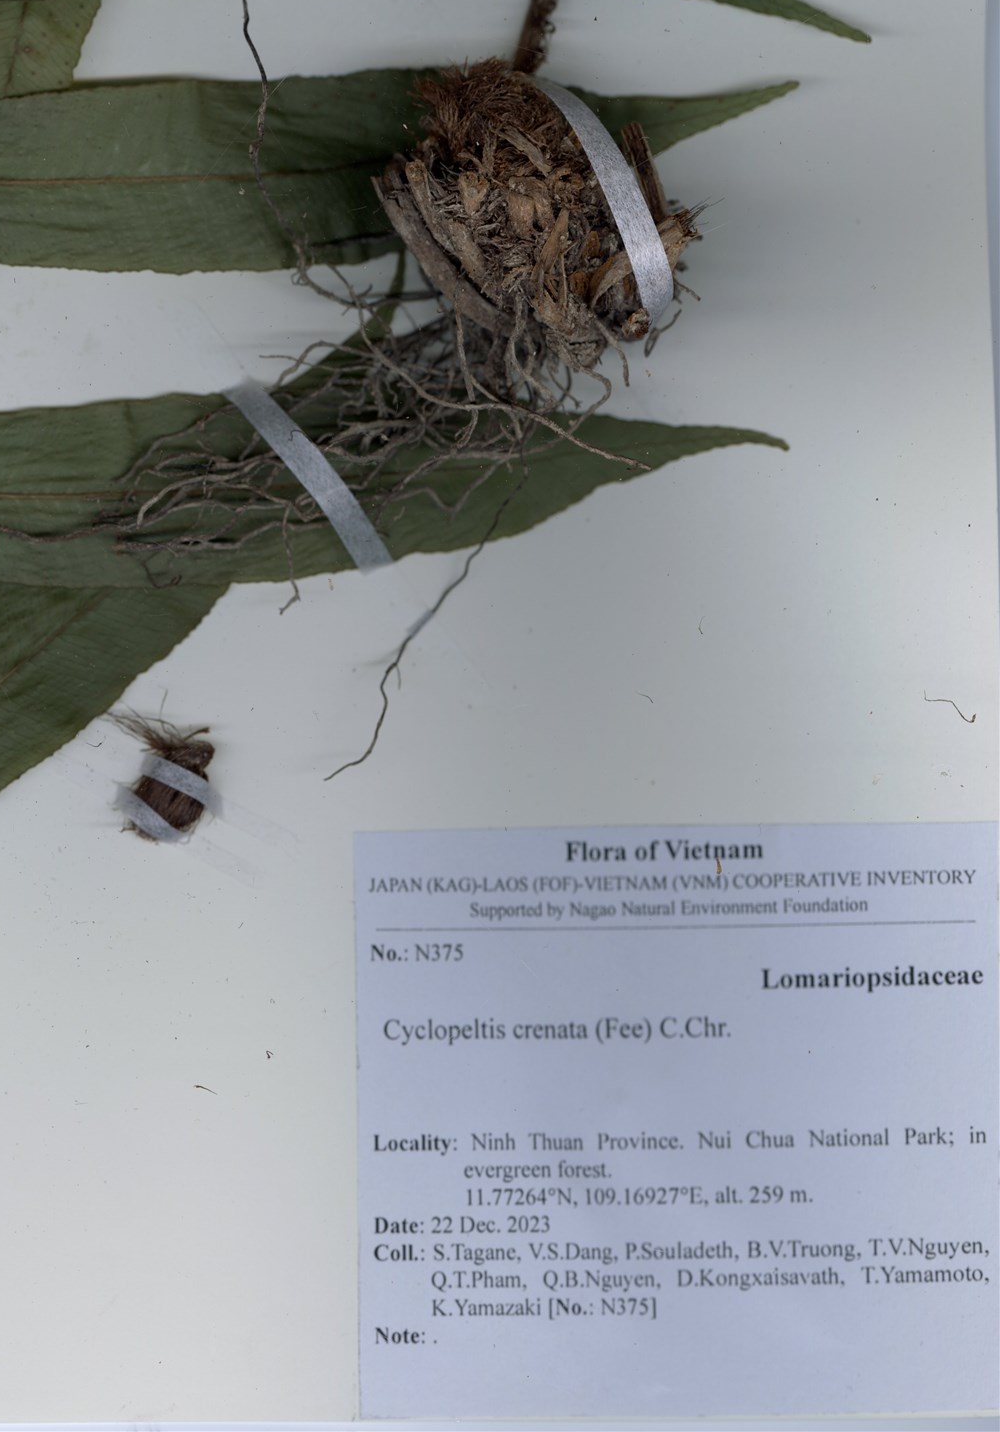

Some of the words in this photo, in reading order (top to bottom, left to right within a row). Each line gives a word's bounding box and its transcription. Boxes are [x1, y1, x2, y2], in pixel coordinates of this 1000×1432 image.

[565, 840, 627, 863] Flora
[634, 839, 660, 862] of
[665, 840, 763, 860] Vietnam
[369, 877, 423, 893] JAPAN
[426, 877, 529, 894] (KAG)-LAOS
[532, 875, 667, 892] (FOF)-VIETNAM
[672, 873, 728, 891] (VNM)
[732, 872, 862, 889] COOPERATIVE
[866, 869, 976, 887] INVENTORY
[470, 902, 543, 921] Supported
[547, 903, 564, 919] by
[569, 902, 617, 921] Nagao
[621, 901, 675, 916] Natural
[680, 900, 778, 916] Environment
[783, 897, 868, 914] Foundation
[370, 943, 408, 962] No.:
[415, 943, 464, 962] N375
[760, 965, 984, 994] Lomariopsidaceae
[383, 1017, 507, 1046] Cyclopeltis
[512, 1021, 588, 1040] crenata
[595, 1017, 652, 1044] (Fee)
[659, 1015, 731, 1039] C.Chr.
[373, 1133, 458, 1157] Locality:
[471, 1132, 516, 1151] Ninh
[528, 1132, 584, 1151] Thuan
[597, 1131, 684, 1151] Province.
[697, 1130, 732, 1150] Nui
[745, 1130, 795, 1149] Chua
[808, 1127, 889, 1148] National
[904, 1126, 955, 1148] Park;
[969, 1125, 987, 1145] in
[463, 1164, 552, 1184] evergreen
[558, 1160, 612, 1179] forest.
[715, 1185, 743, 1204] alt.
[749, 1185, 784, 1204] 259
[789, 1189, 814, 1204] m.
[374, 1216, 425, 1235] Date:
[431, 1215, 454, 1235] 22
[460, 1215, 501, 1234] Dec.
[507, 1214, 551, 1234] 2023
[373, 1243, 425, 1262] Coll.:
[433, 1243, 522, 1266] S.Tagane,
[528, 1242, 619, 1266] V.S.Dang,
[625, 1240, 740, 1261] P.Souladeth,
[747, 1239, 862, 1263] B.V.Truong,
[867, 1237, 990, 1261] T.V.Nguyen,
[430, 1269, 528, 1293] Q.T.Pham,
[542, 1269, 662, 1293] Q.B.Nguyen,
[677, 1266, 845, 1292] D.Kongxaisavath,
[860, 1265, 990, 1285] T.Yamamoto,
[432, 1297, 542, 1317] K.Yamazaki
[548, 1297, 594, 1321] [No.:
[601, 1296, 657, 1320] N375]
[374, 1326, 426, 1345] Note:
